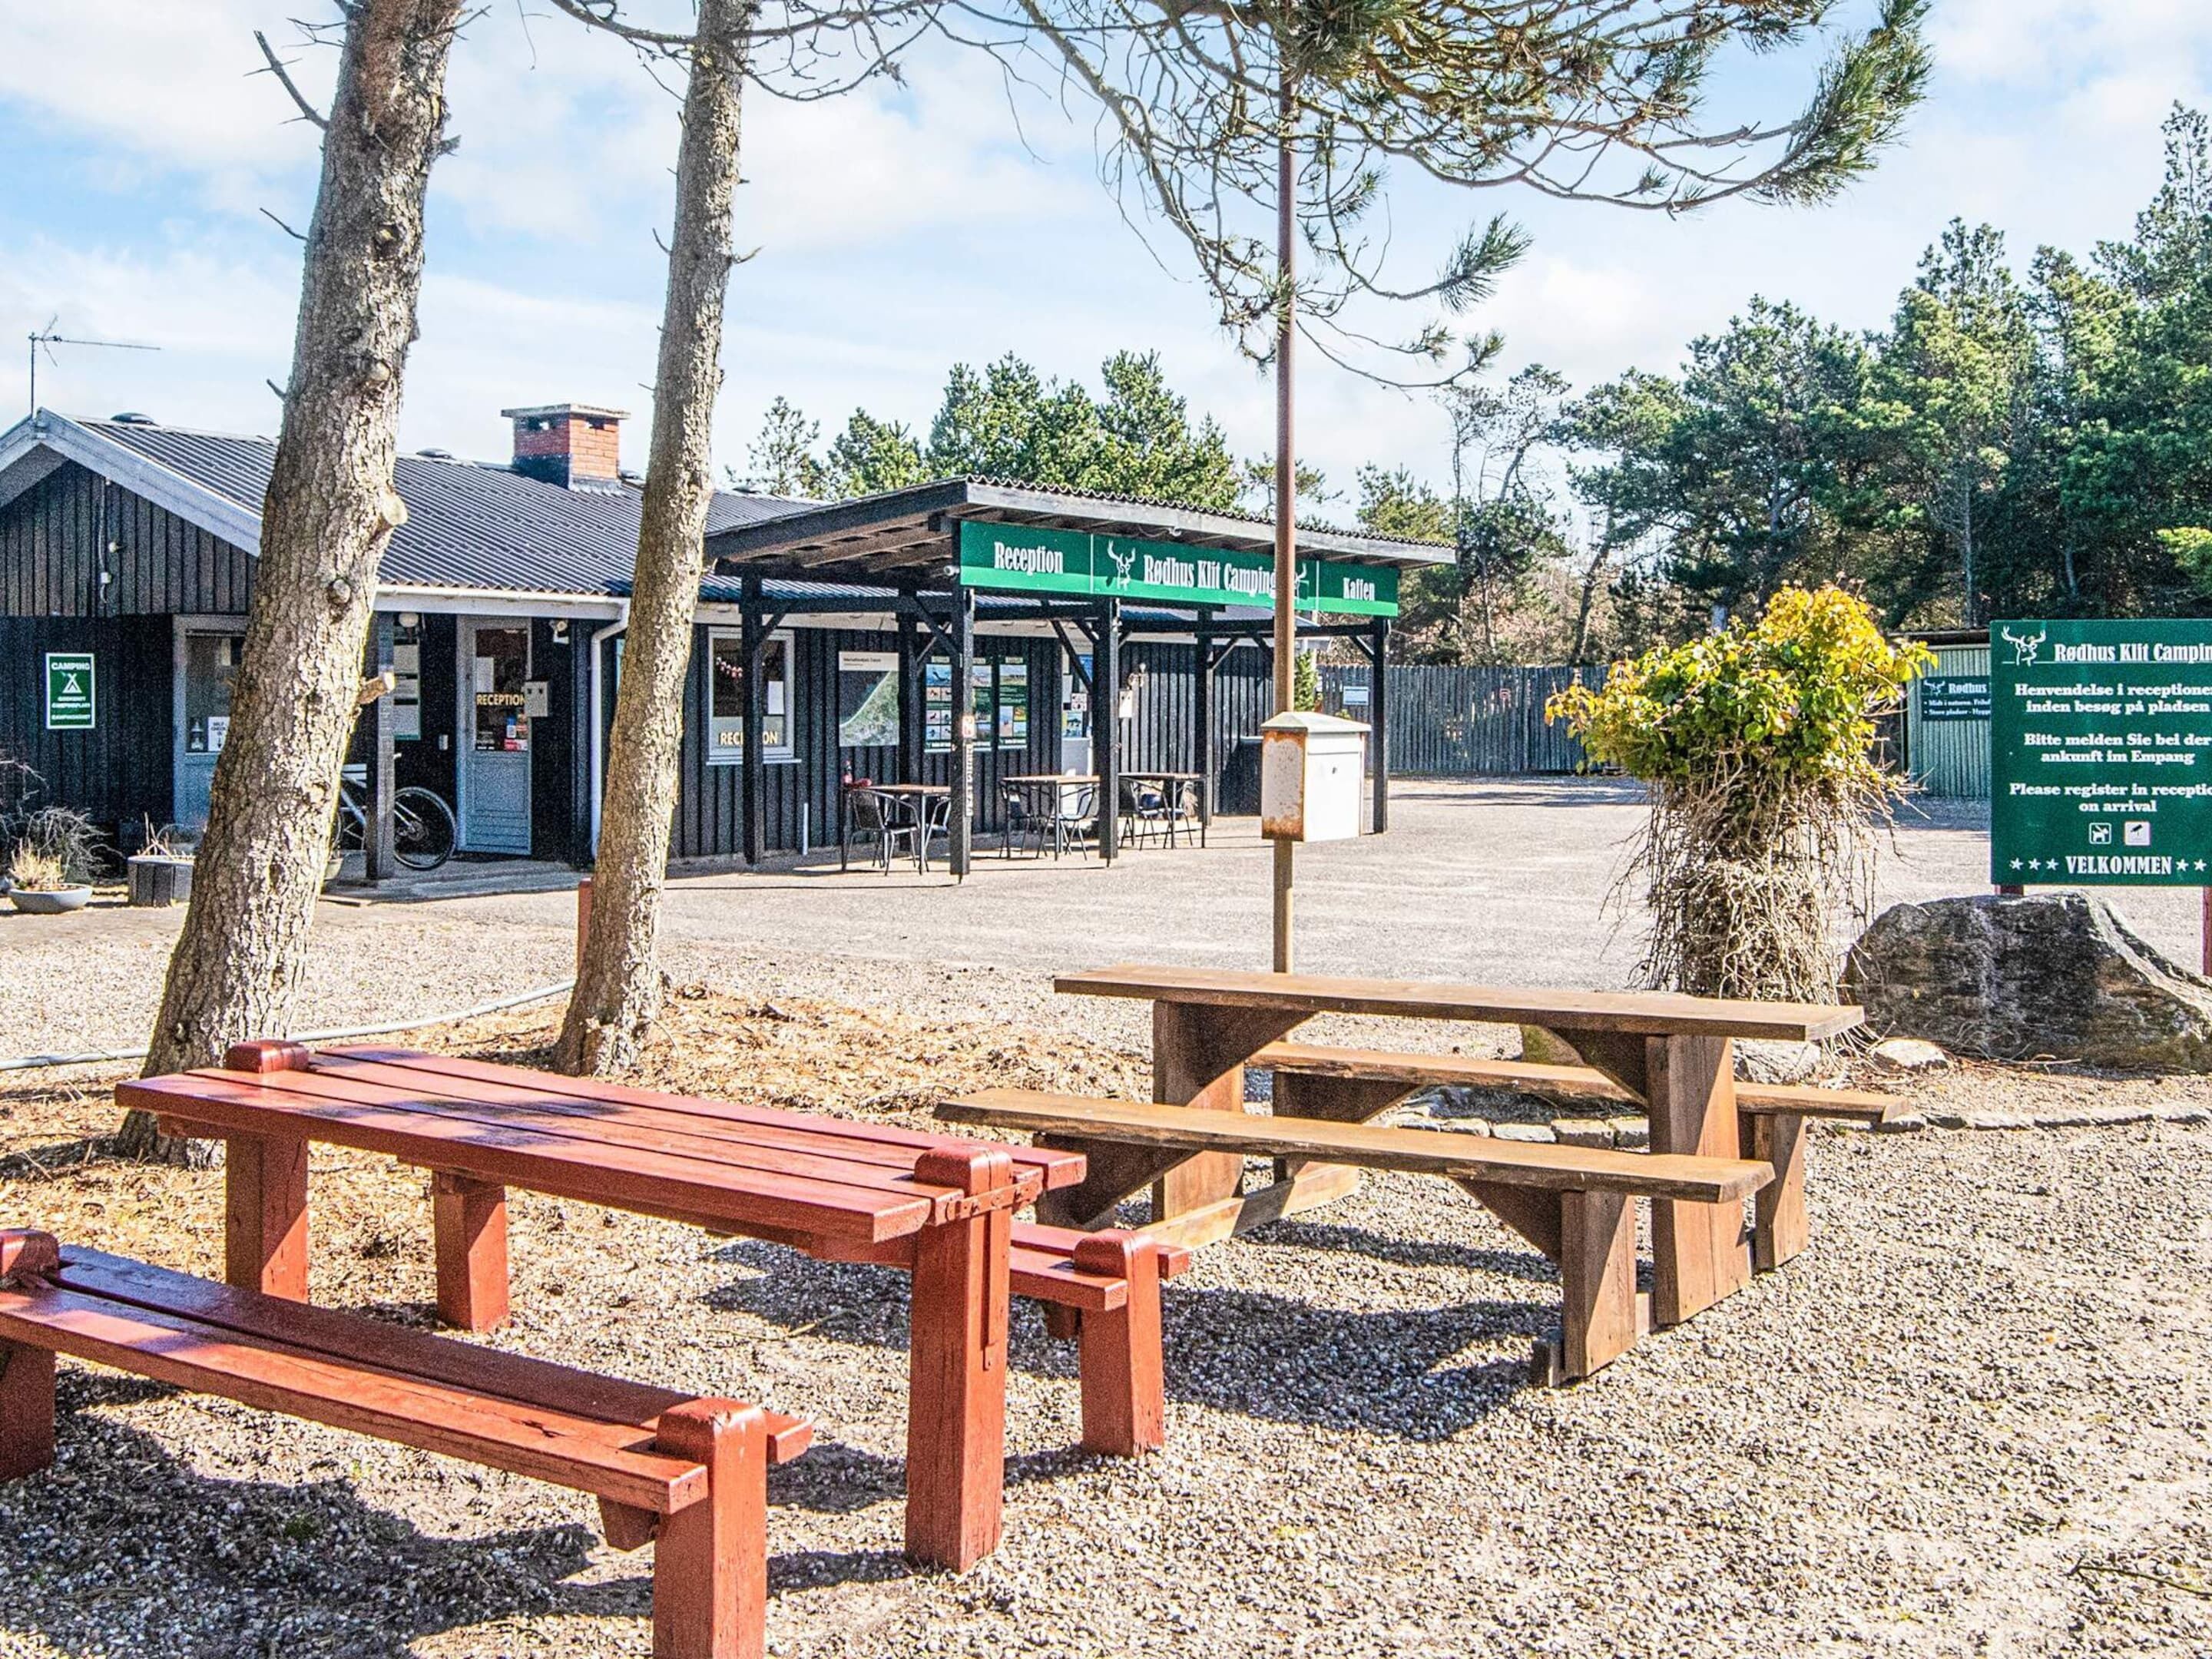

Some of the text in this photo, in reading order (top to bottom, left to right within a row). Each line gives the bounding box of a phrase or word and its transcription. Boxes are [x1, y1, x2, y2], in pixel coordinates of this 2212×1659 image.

[994, 541, 1064, 576] Reception
[1144, 555, 1277, 598] Rødhus Klit Camping
[2055, 643, 2115, 662] Rødhus
[2120, 643, 2150, 662] Klit
[51, 662, 91, 671] CAMPING
[1949, 683, 1988, 694] Rødhus
[2015, 683, 2212, 698] Henvendelse i receptione
[2026, 700, 2210, 715] inden besøg på pladsen
[2024, 733, 2212, 746] Bitte melden Sie bei der
[2041, 750, 2195, 765] ankunft im Empang
[2009, 783, 2061, 796] Please
[2065, 783, 2128, 797] register
[2131, 783, 2148, 796] in
[2078, 800, 2157, 812] on arrival
[2066, 856, 2172, 875] VELKOMMEN
